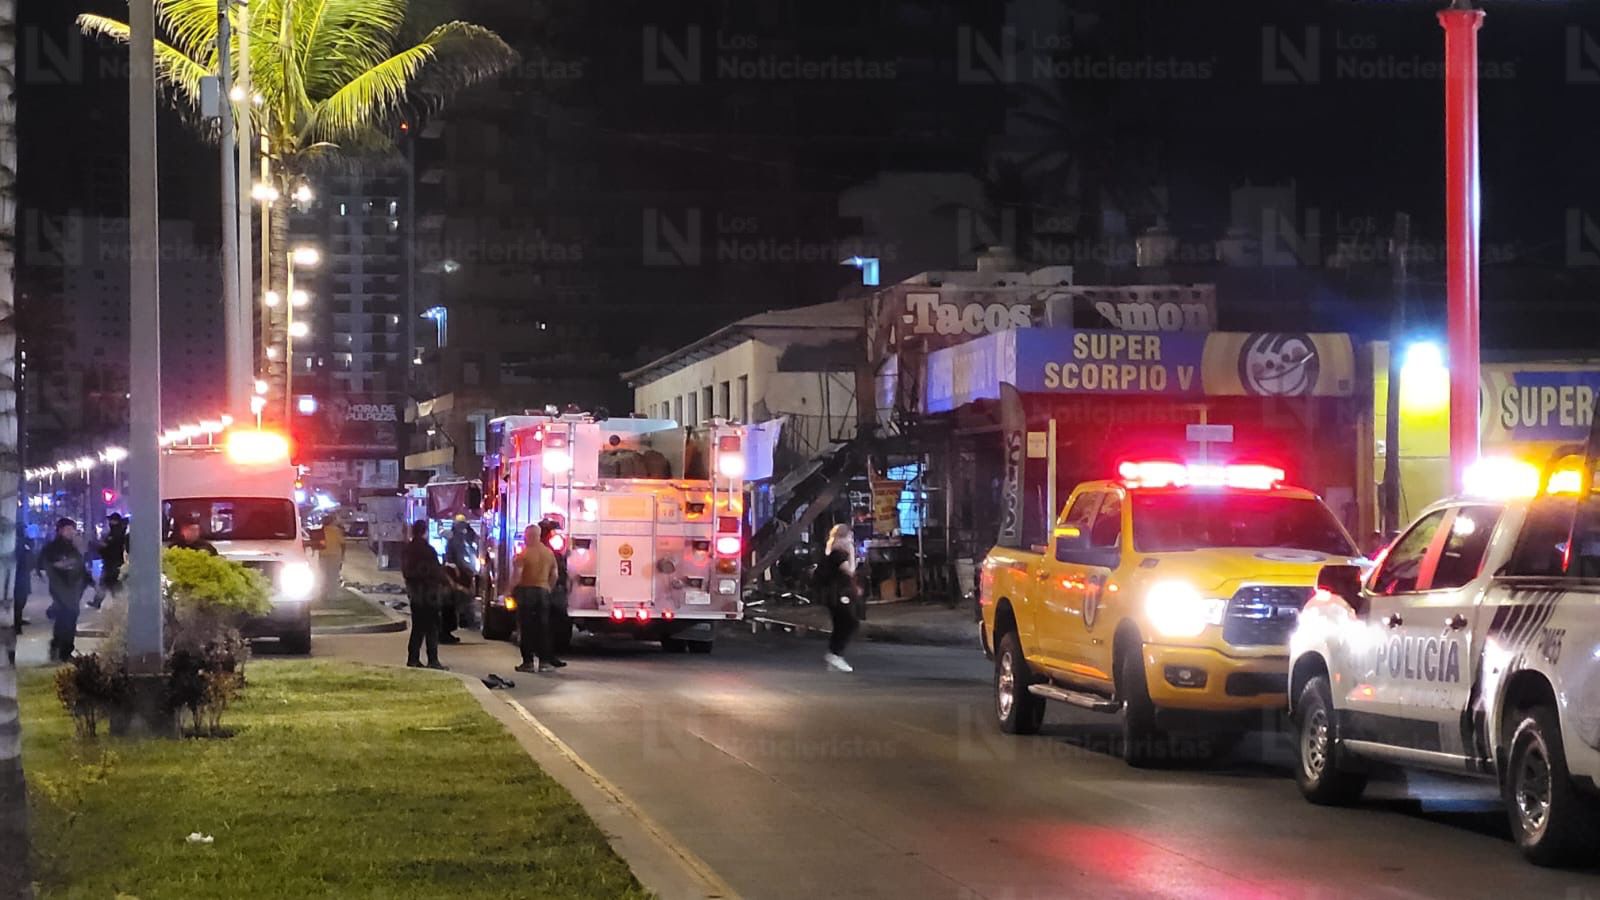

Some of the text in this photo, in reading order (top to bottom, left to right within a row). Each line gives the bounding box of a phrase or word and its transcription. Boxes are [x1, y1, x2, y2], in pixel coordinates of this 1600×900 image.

[906, 293, 1032, 335] Tacos
[1073, 333, 1161, 360] SUPER
[1044, 362, 1194, 391] SCORPIO V
[1502, 385, 1593, 427] SUPER
[620, 560, 632, 576] 5
